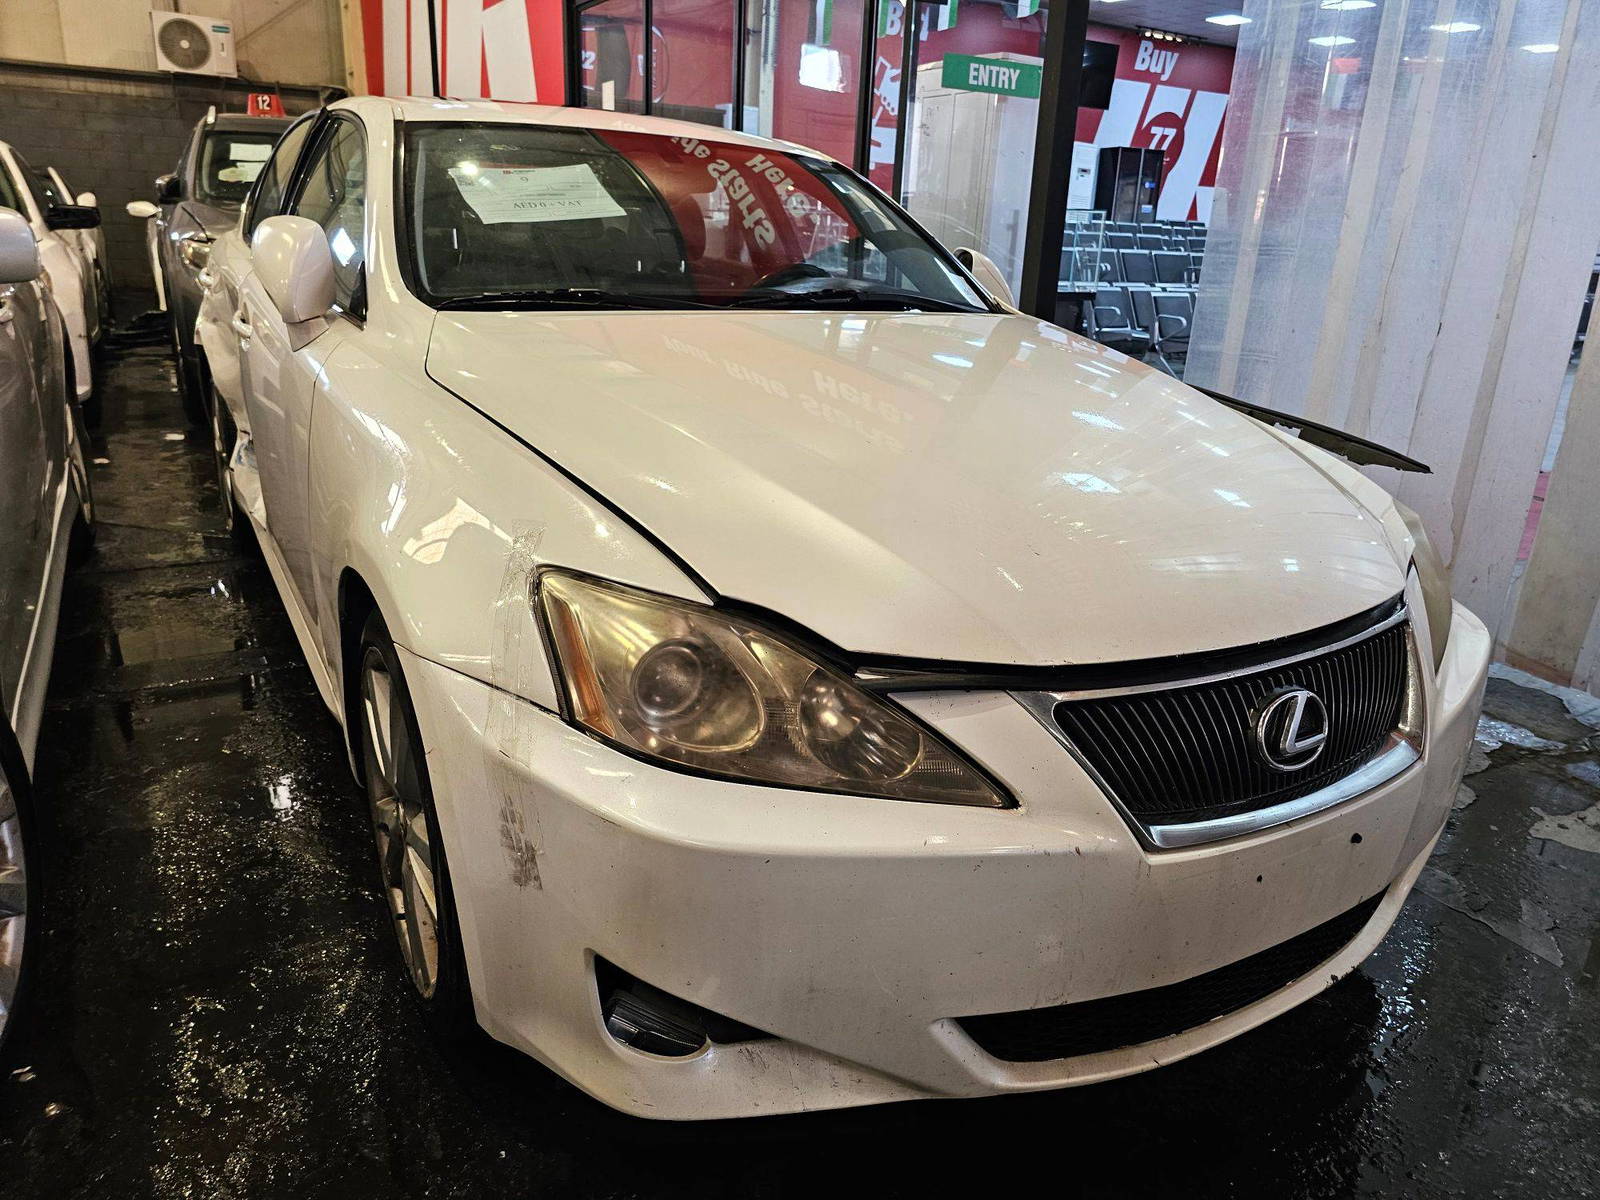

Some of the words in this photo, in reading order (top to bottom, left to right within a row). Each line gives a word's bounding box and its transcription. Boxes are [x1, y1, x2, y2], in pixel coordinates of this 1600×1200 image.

[1134, 40, 1179, 82] Buy
[968, 62, 1021, 90] ENTRY
[257, 94, 271, 110] 12
[1149, 125, 1177, 150] 77
